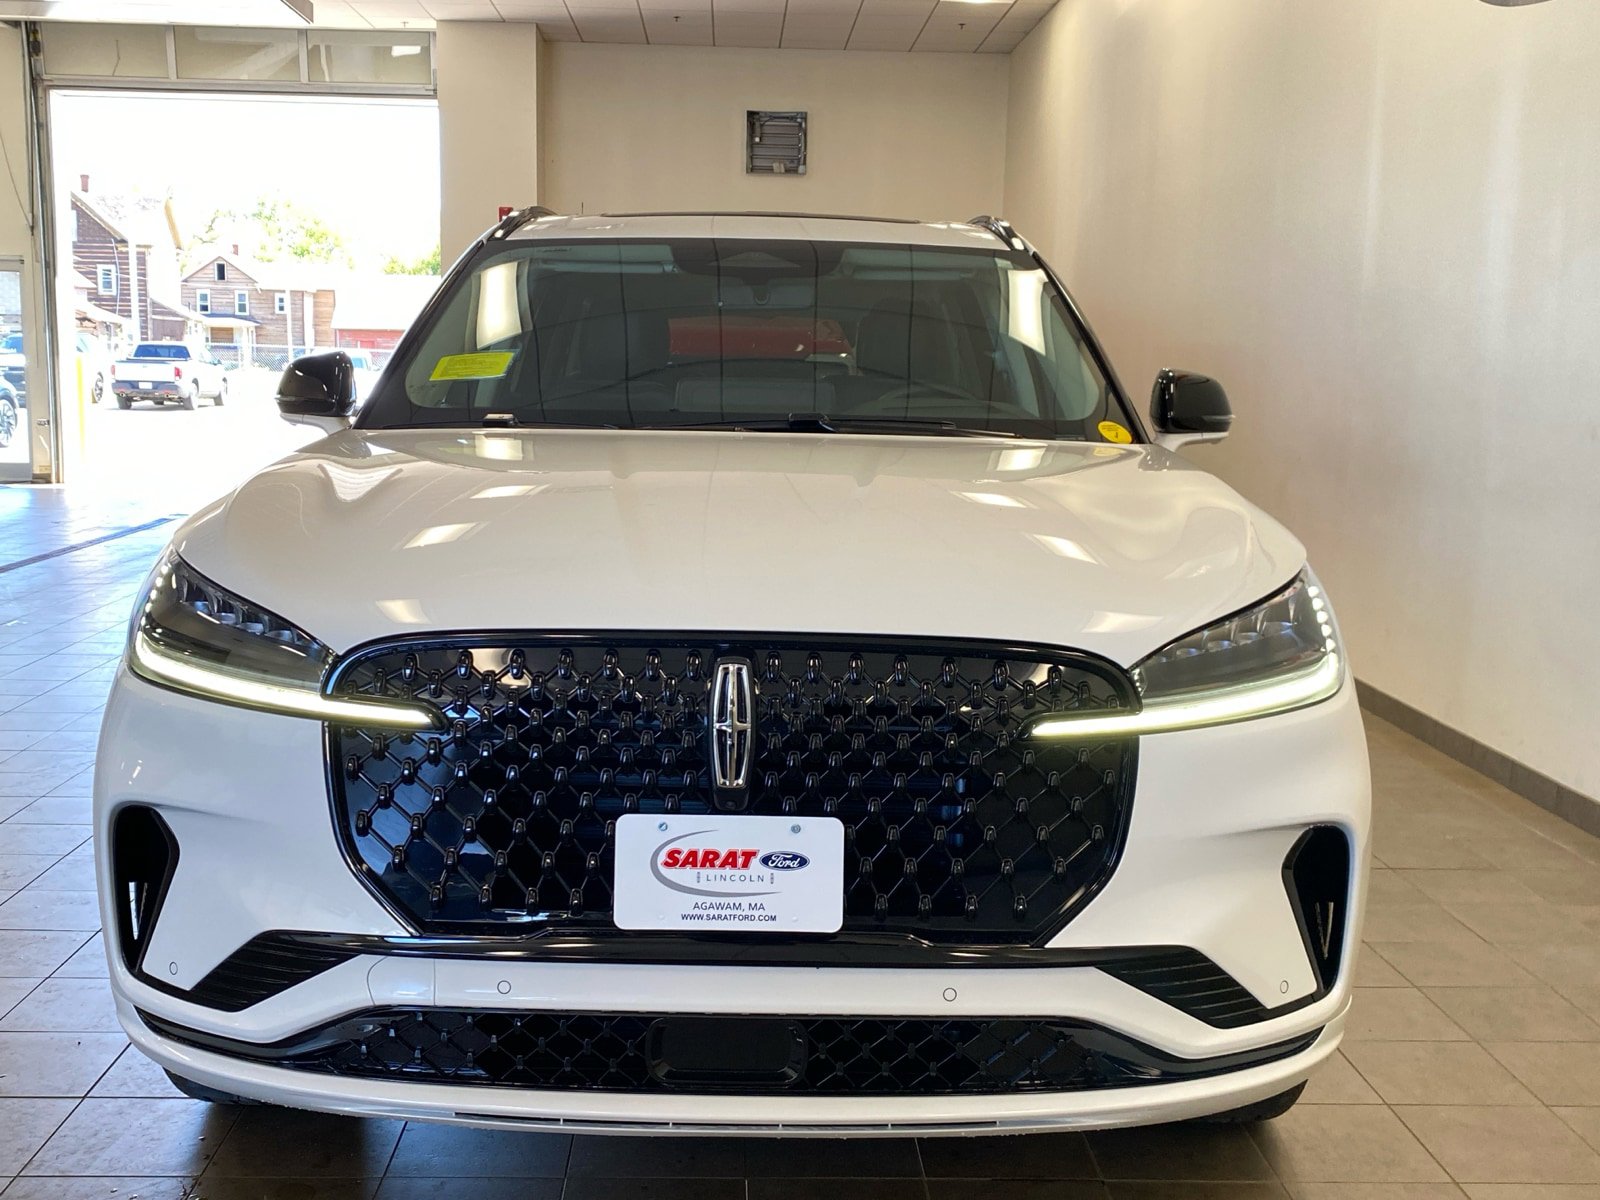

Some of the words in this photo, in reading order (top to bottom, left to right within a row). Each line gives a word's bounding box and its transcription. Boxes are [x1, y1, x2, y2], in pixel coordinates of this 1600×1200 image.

[661, 848, 759, 870] SARAT
[767, 853, 801, 868] Ford
[706, 874, 765, 883] LINCOLN
[693, 902, 745, 912] AGAWAM,
[748, 902, 766, 911] MA
[681, 913, 777, 922] WWW.SARATFORD.COM
